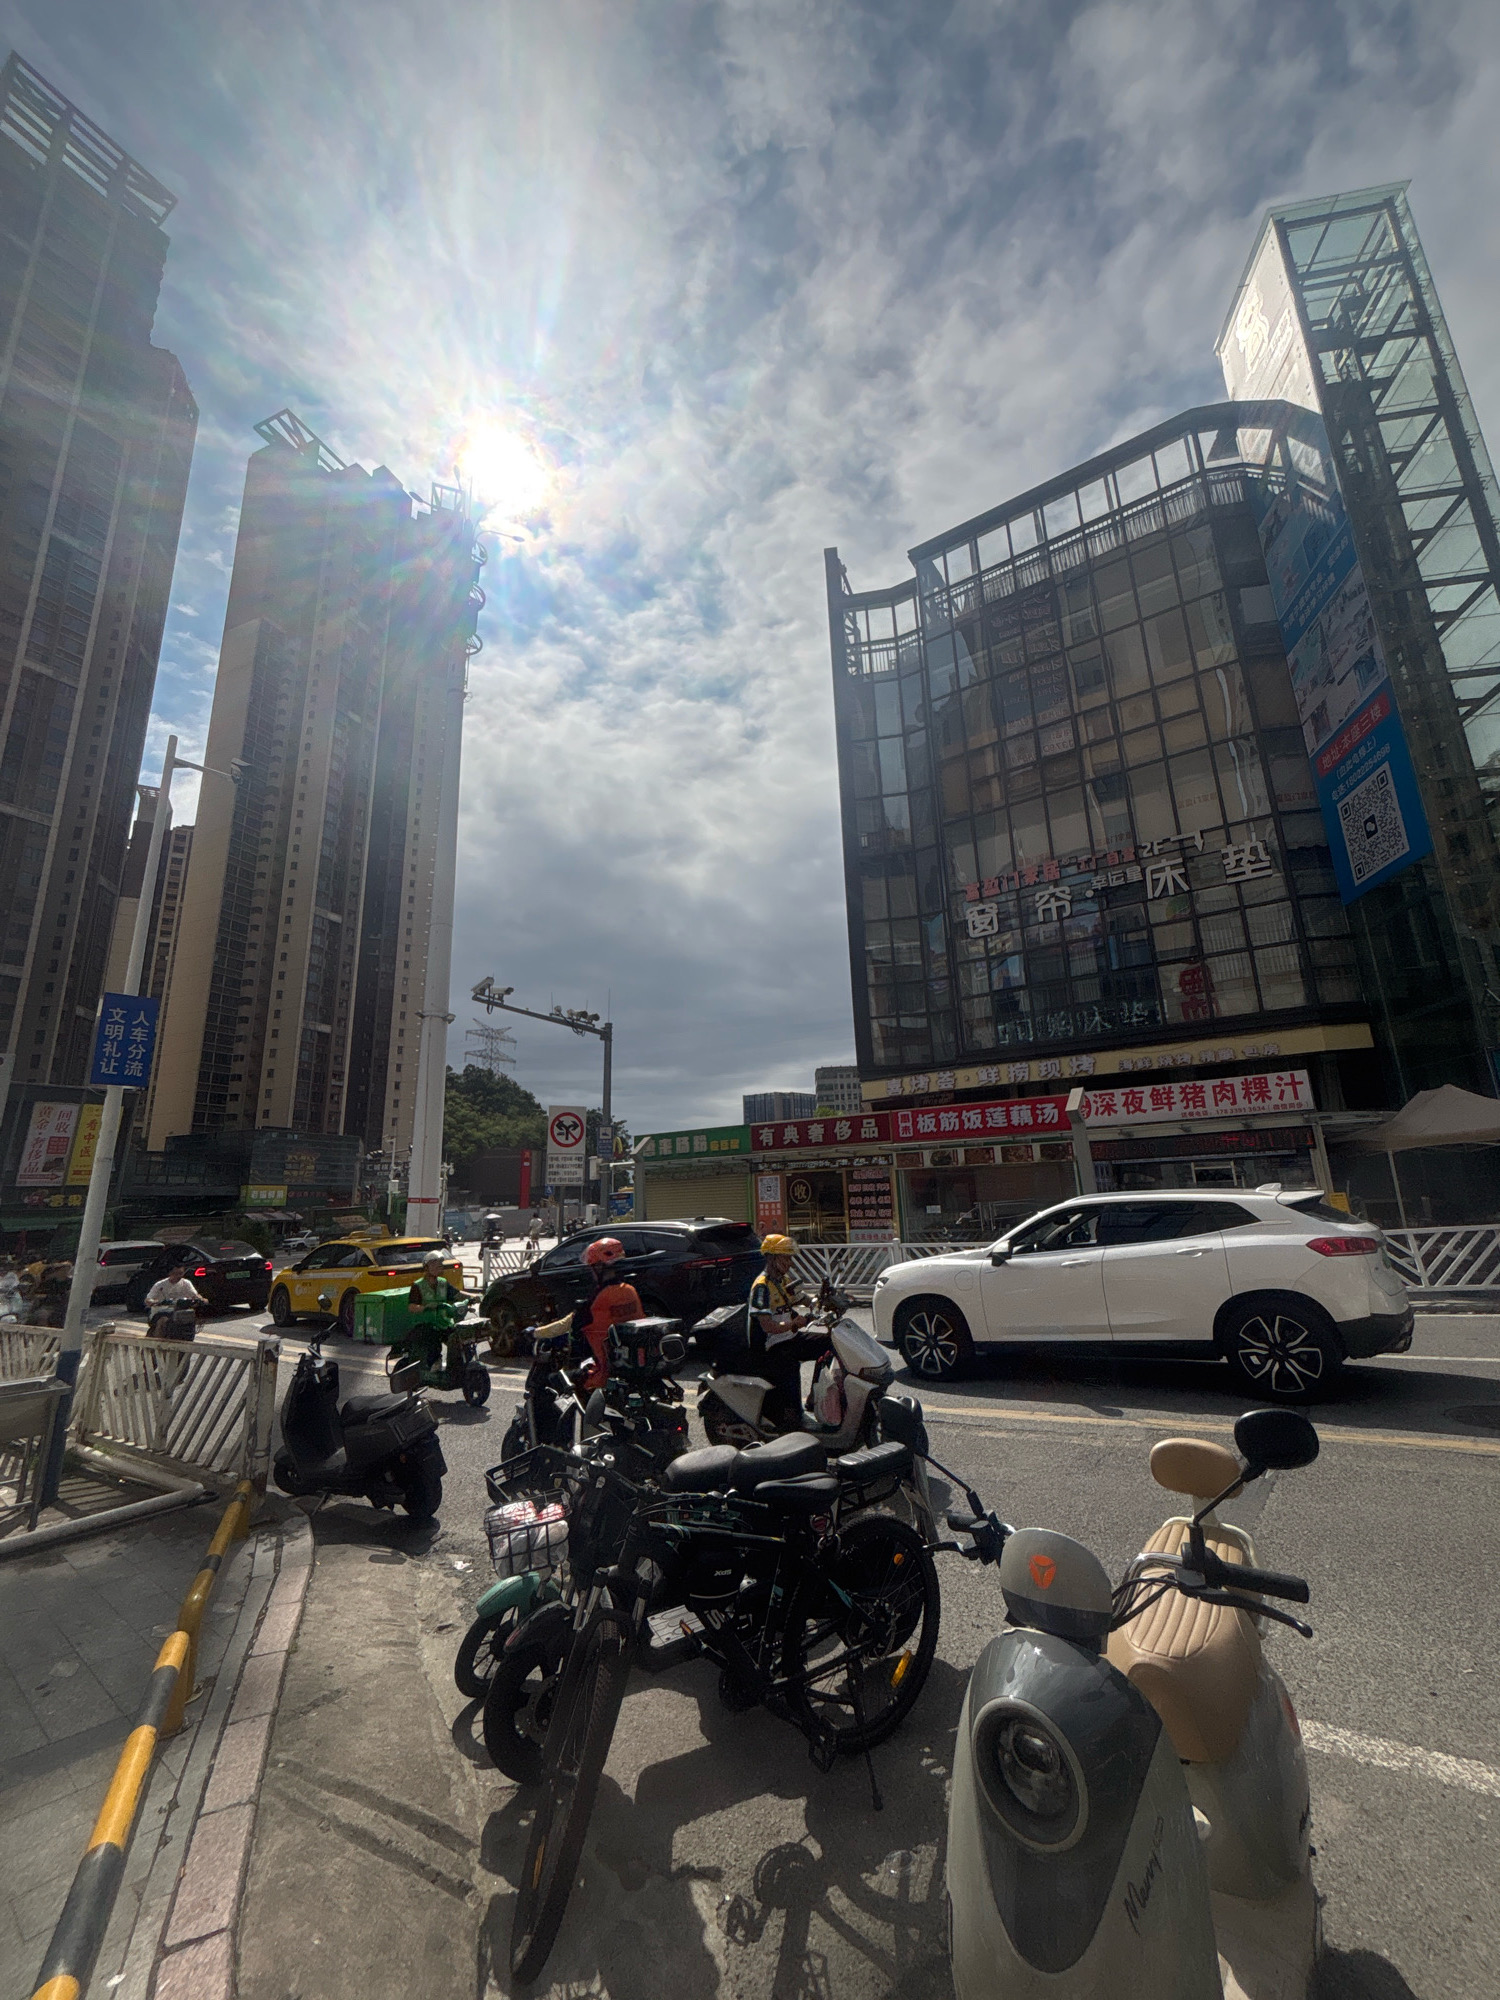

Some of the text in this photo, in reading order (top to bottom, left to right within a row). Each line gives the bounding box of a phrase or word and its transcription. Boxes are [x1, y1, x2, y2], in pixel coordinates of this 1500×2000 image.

[1141, 841, 1165, 857] 2F
[1091, 865, 1144, 891] 幸运星
[99, 1007, 128, 1075] 文明礼让
[124, 1010, 150, 1077] 人车分流
[1092, 1072, 1304, 1117] 深夜鲜猪肉粿汁
[54, 1110, 72, 1134] 回收
[759, 1118, 879, 1148] 有典奢侈品
[916, 1102, 1059, 1134] 板筋饭莲藕汤
[79, 1119, 99, 1158] 看中医
[794, 1184, 807, 1200] 收
